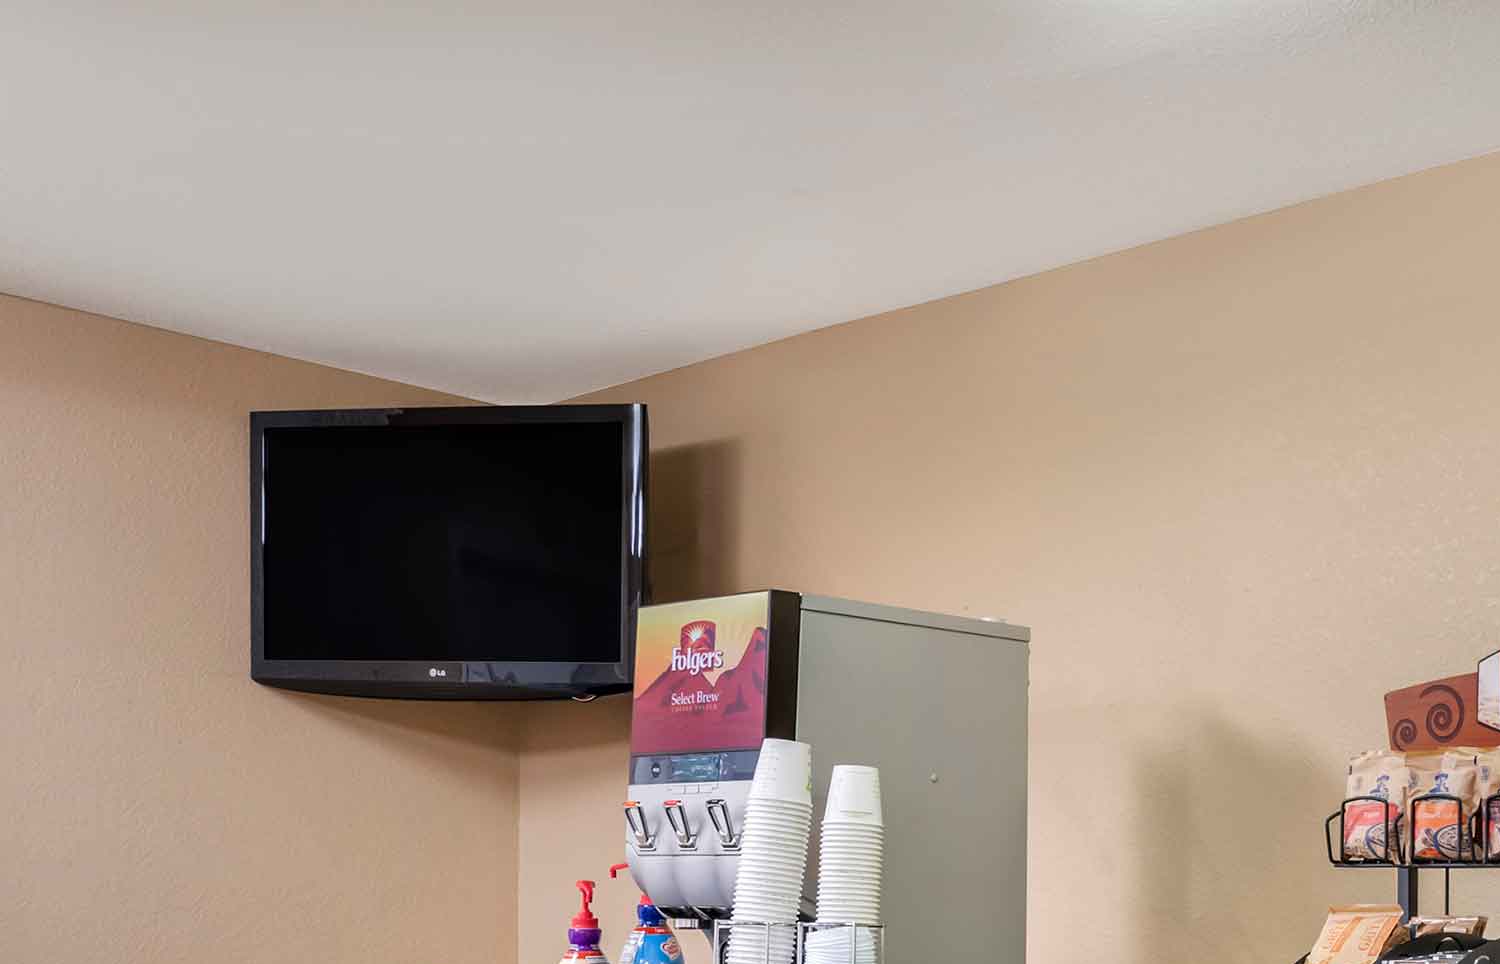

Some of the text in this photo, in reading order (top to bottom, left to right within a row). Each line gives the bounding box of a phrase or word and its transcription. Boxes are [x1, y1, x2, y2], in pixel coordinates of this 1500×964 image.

[671, 647, 724, 676] Folgers
[671, 690, 720, 705] Select Brew
